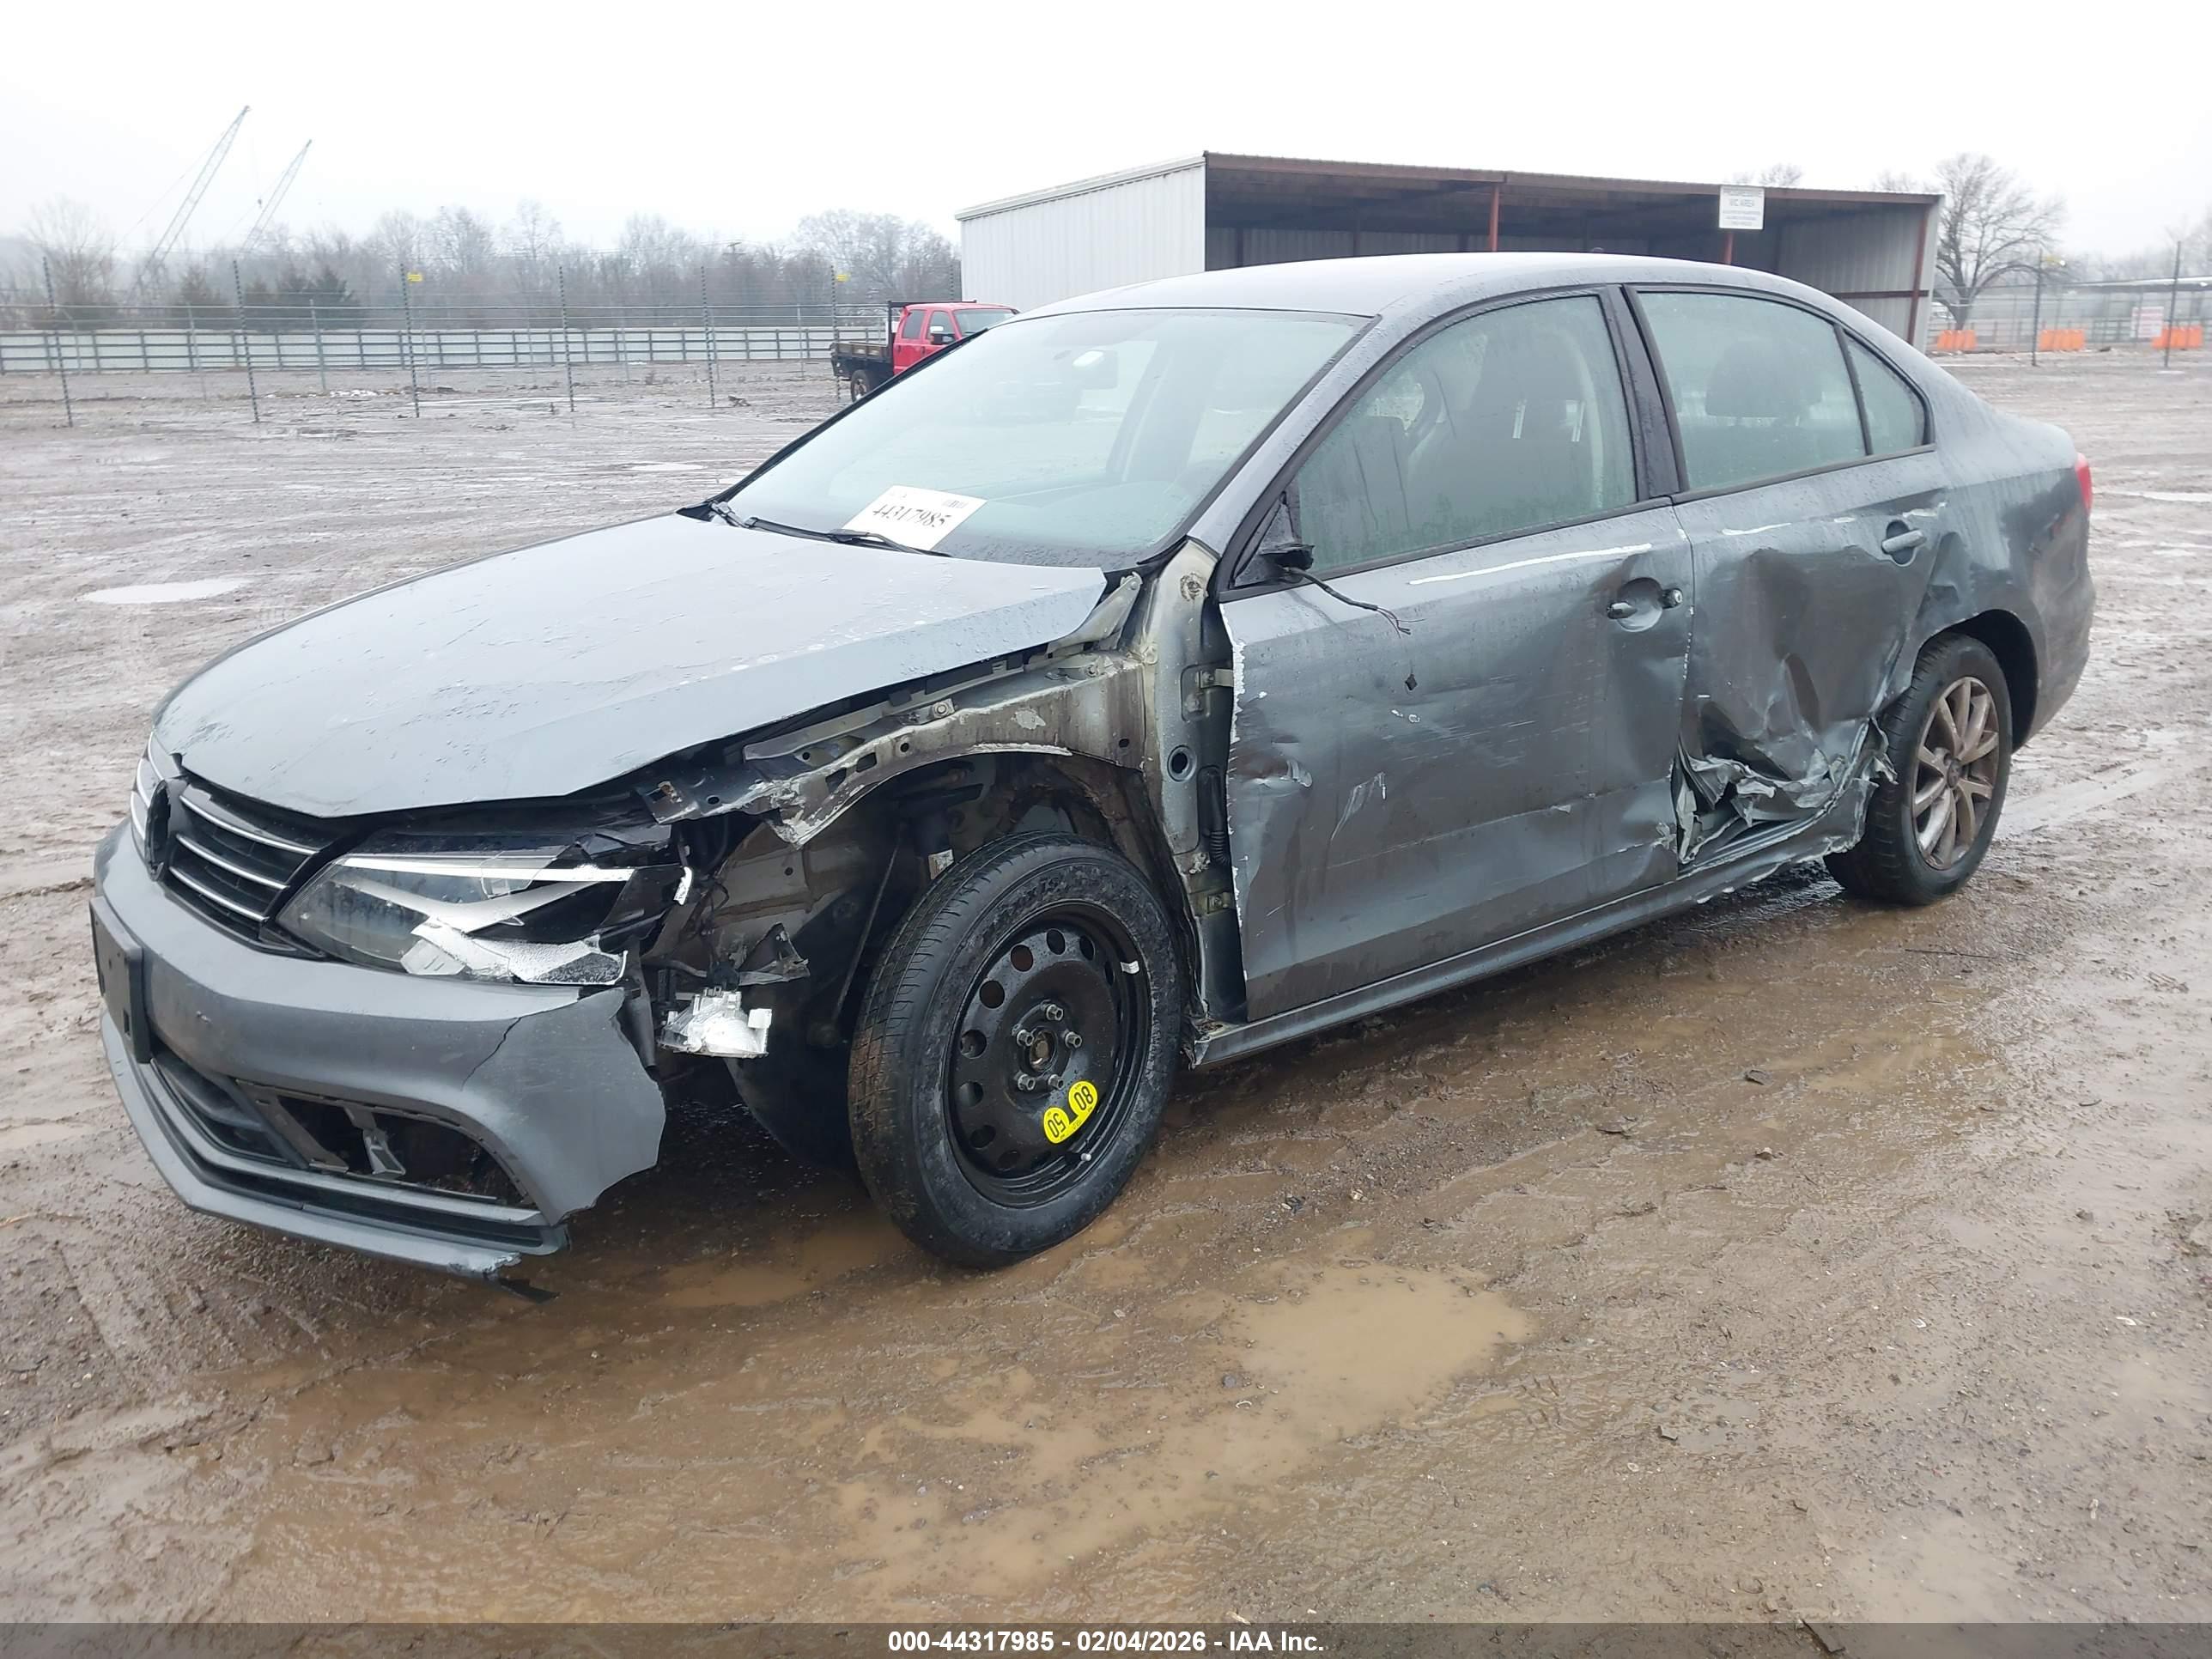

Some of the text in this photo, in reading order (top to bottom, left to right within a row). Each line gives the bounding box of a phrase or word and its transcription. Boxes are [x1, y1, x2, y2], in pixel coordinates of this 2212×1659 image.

[872, 503, 952, 527] 44317985
[1073, 1085, 1094, 1111] 80
[1047, 1112, 1066, 1138] 50
